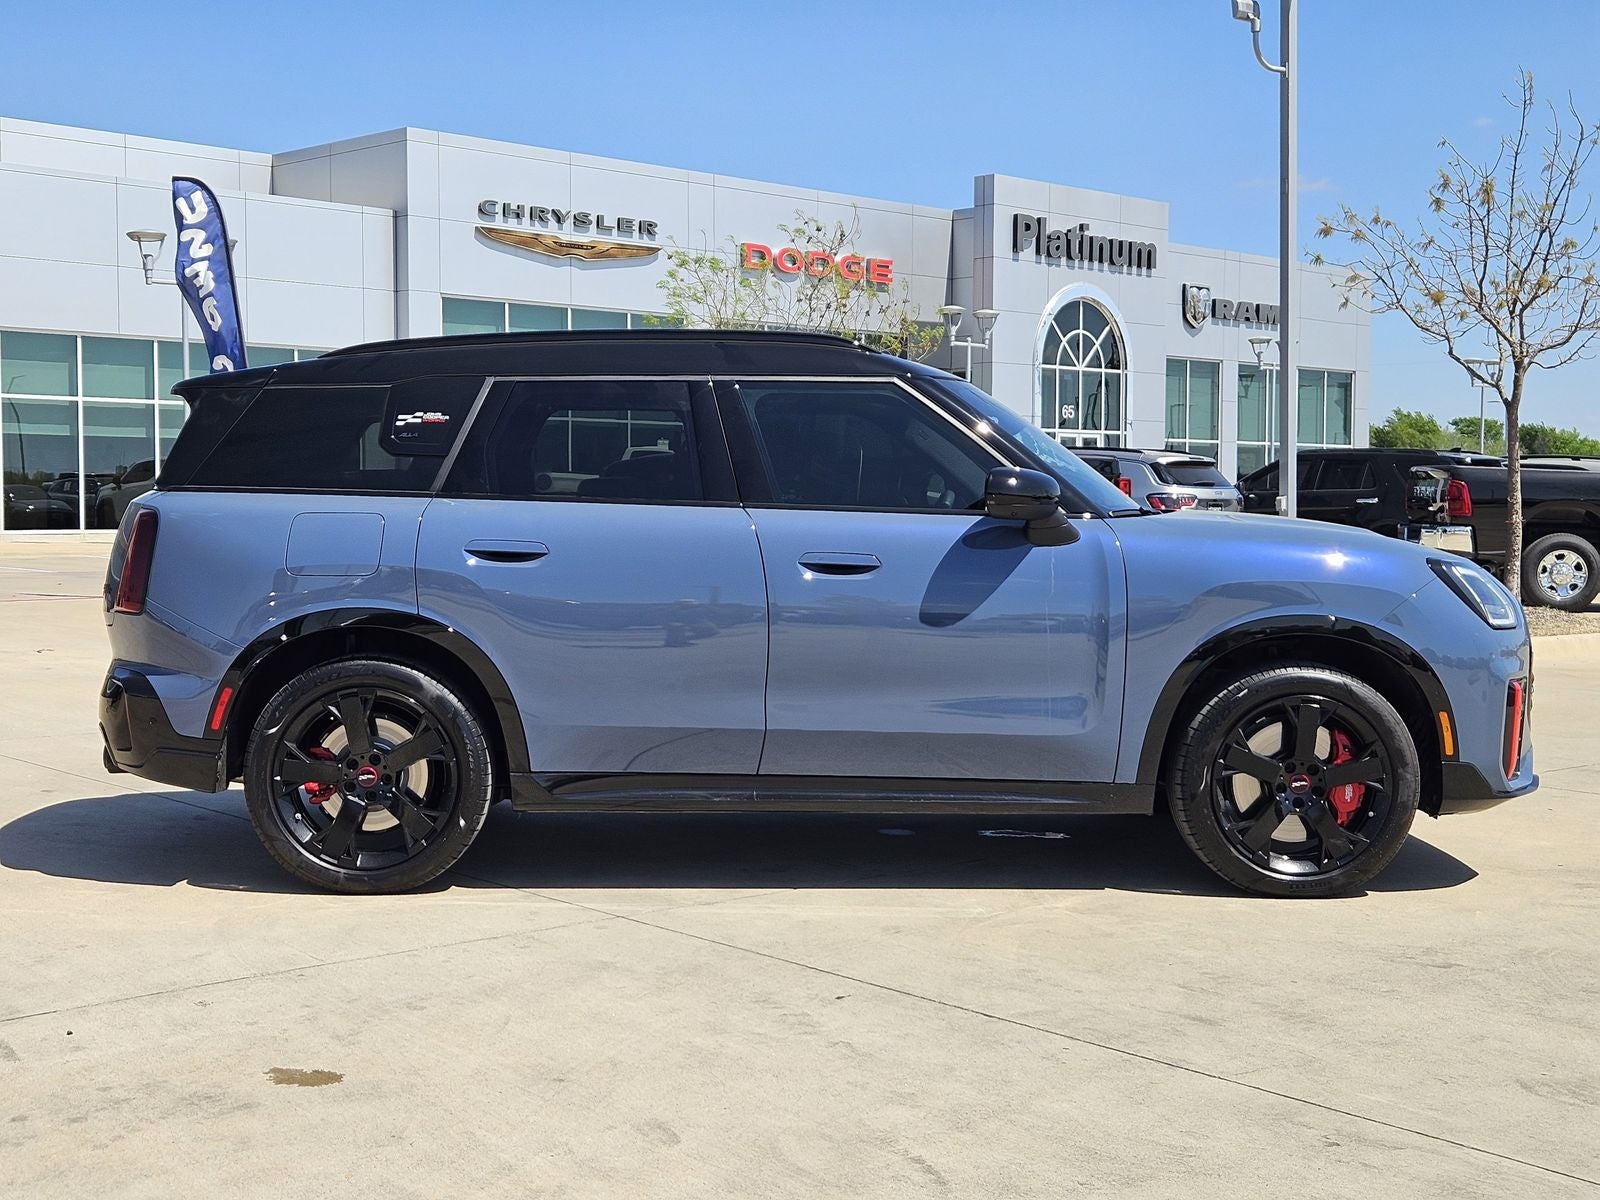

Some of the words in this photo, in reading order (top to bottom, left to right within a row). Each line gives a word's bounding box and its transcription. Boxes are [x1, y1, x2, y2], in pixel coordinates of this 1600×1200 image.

[478, 200, 659, 236] CHRYSLER
[1013, 213, 1157, 270] Platinum
[741, 241, 894, 284] DODGE
[1211, 298, 1280, 325] RAM
[1062, 404, 1075, 418] 65
